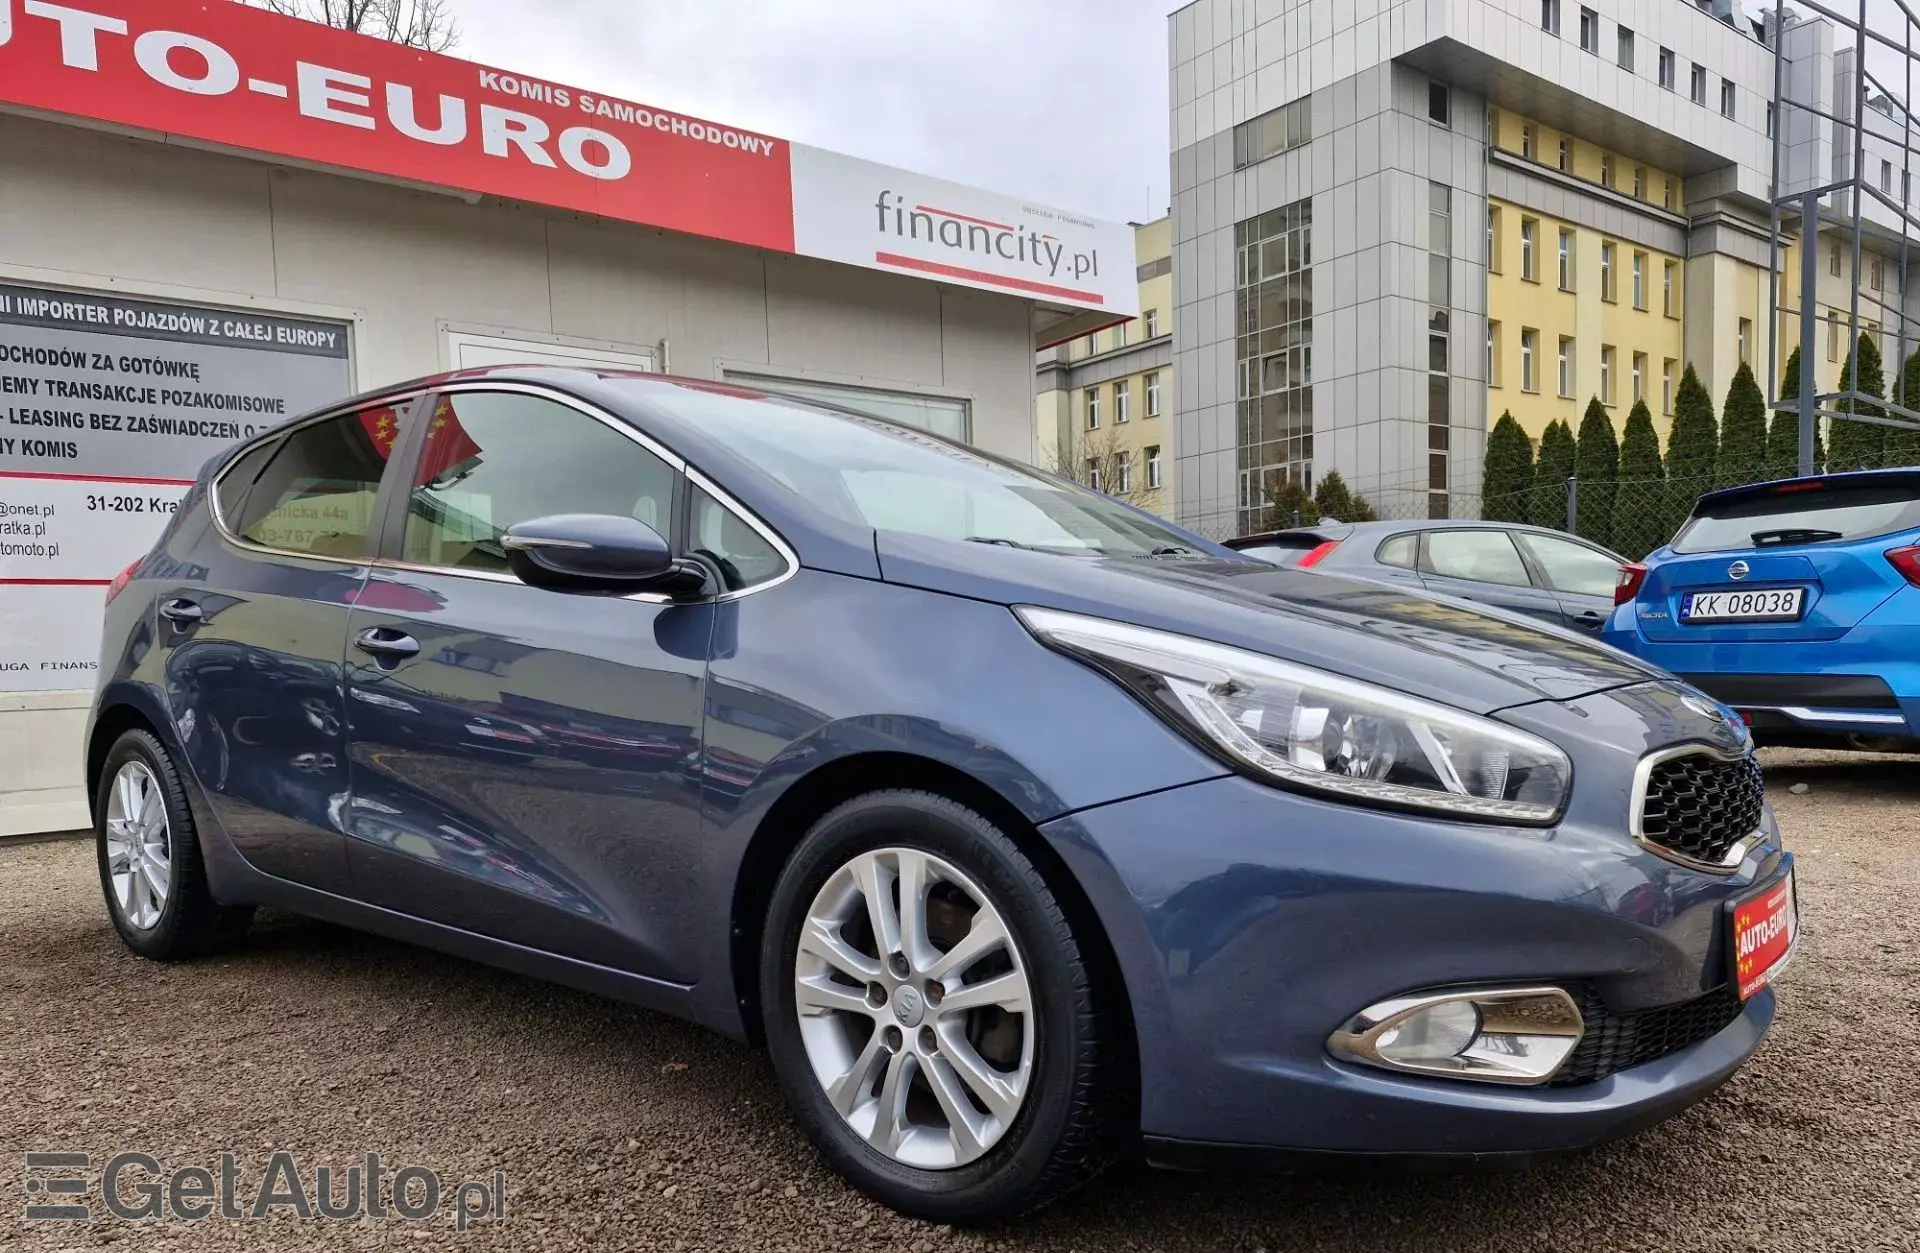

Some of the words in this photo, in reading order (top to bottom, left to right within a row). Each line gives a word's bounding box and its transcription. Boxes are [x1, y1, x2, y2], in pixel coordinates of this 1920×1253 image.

[0, 0, 632, 180] TO-EURO
[479, 69, 571, 108] KOMIS
[579, 95, 774, 156] SAMOCHODOWY
[875, 190, 1098, 280] financity.pl
[17, 297, 109, 324] IMPORTER
[114, 308, 204, 335] POJAZDÓW
[209, 319, 220, 337] Z
[224, 320, 273, 343] CAŁEJ
[277, 326, 336, 349] EUROPY
[91, 353, 114, 371] ZA
[119, 355, 200, 383] GOTÓWKĘ
[0, 375, 39, 395] EMY
[45, 379, 156, 405] TRANSAKCJE
[161, 389, 285, 414] POZAKOMISOWE
[9, 407, 84, 429] LEASING
[90, 413, 122, 431] BEZ
[126, 413, 240, 439] ZAŚWIADCZEŃ
[21, 439, 78, 459] KOMIS
[87, 495, 144, 512] 31-202
[149, 497, 183, 514] Kra
[1694, 595, 1721, 615] KK
[1728, 592, 1794, 615] 08038
[897, 993, 917, 1024] KIA
